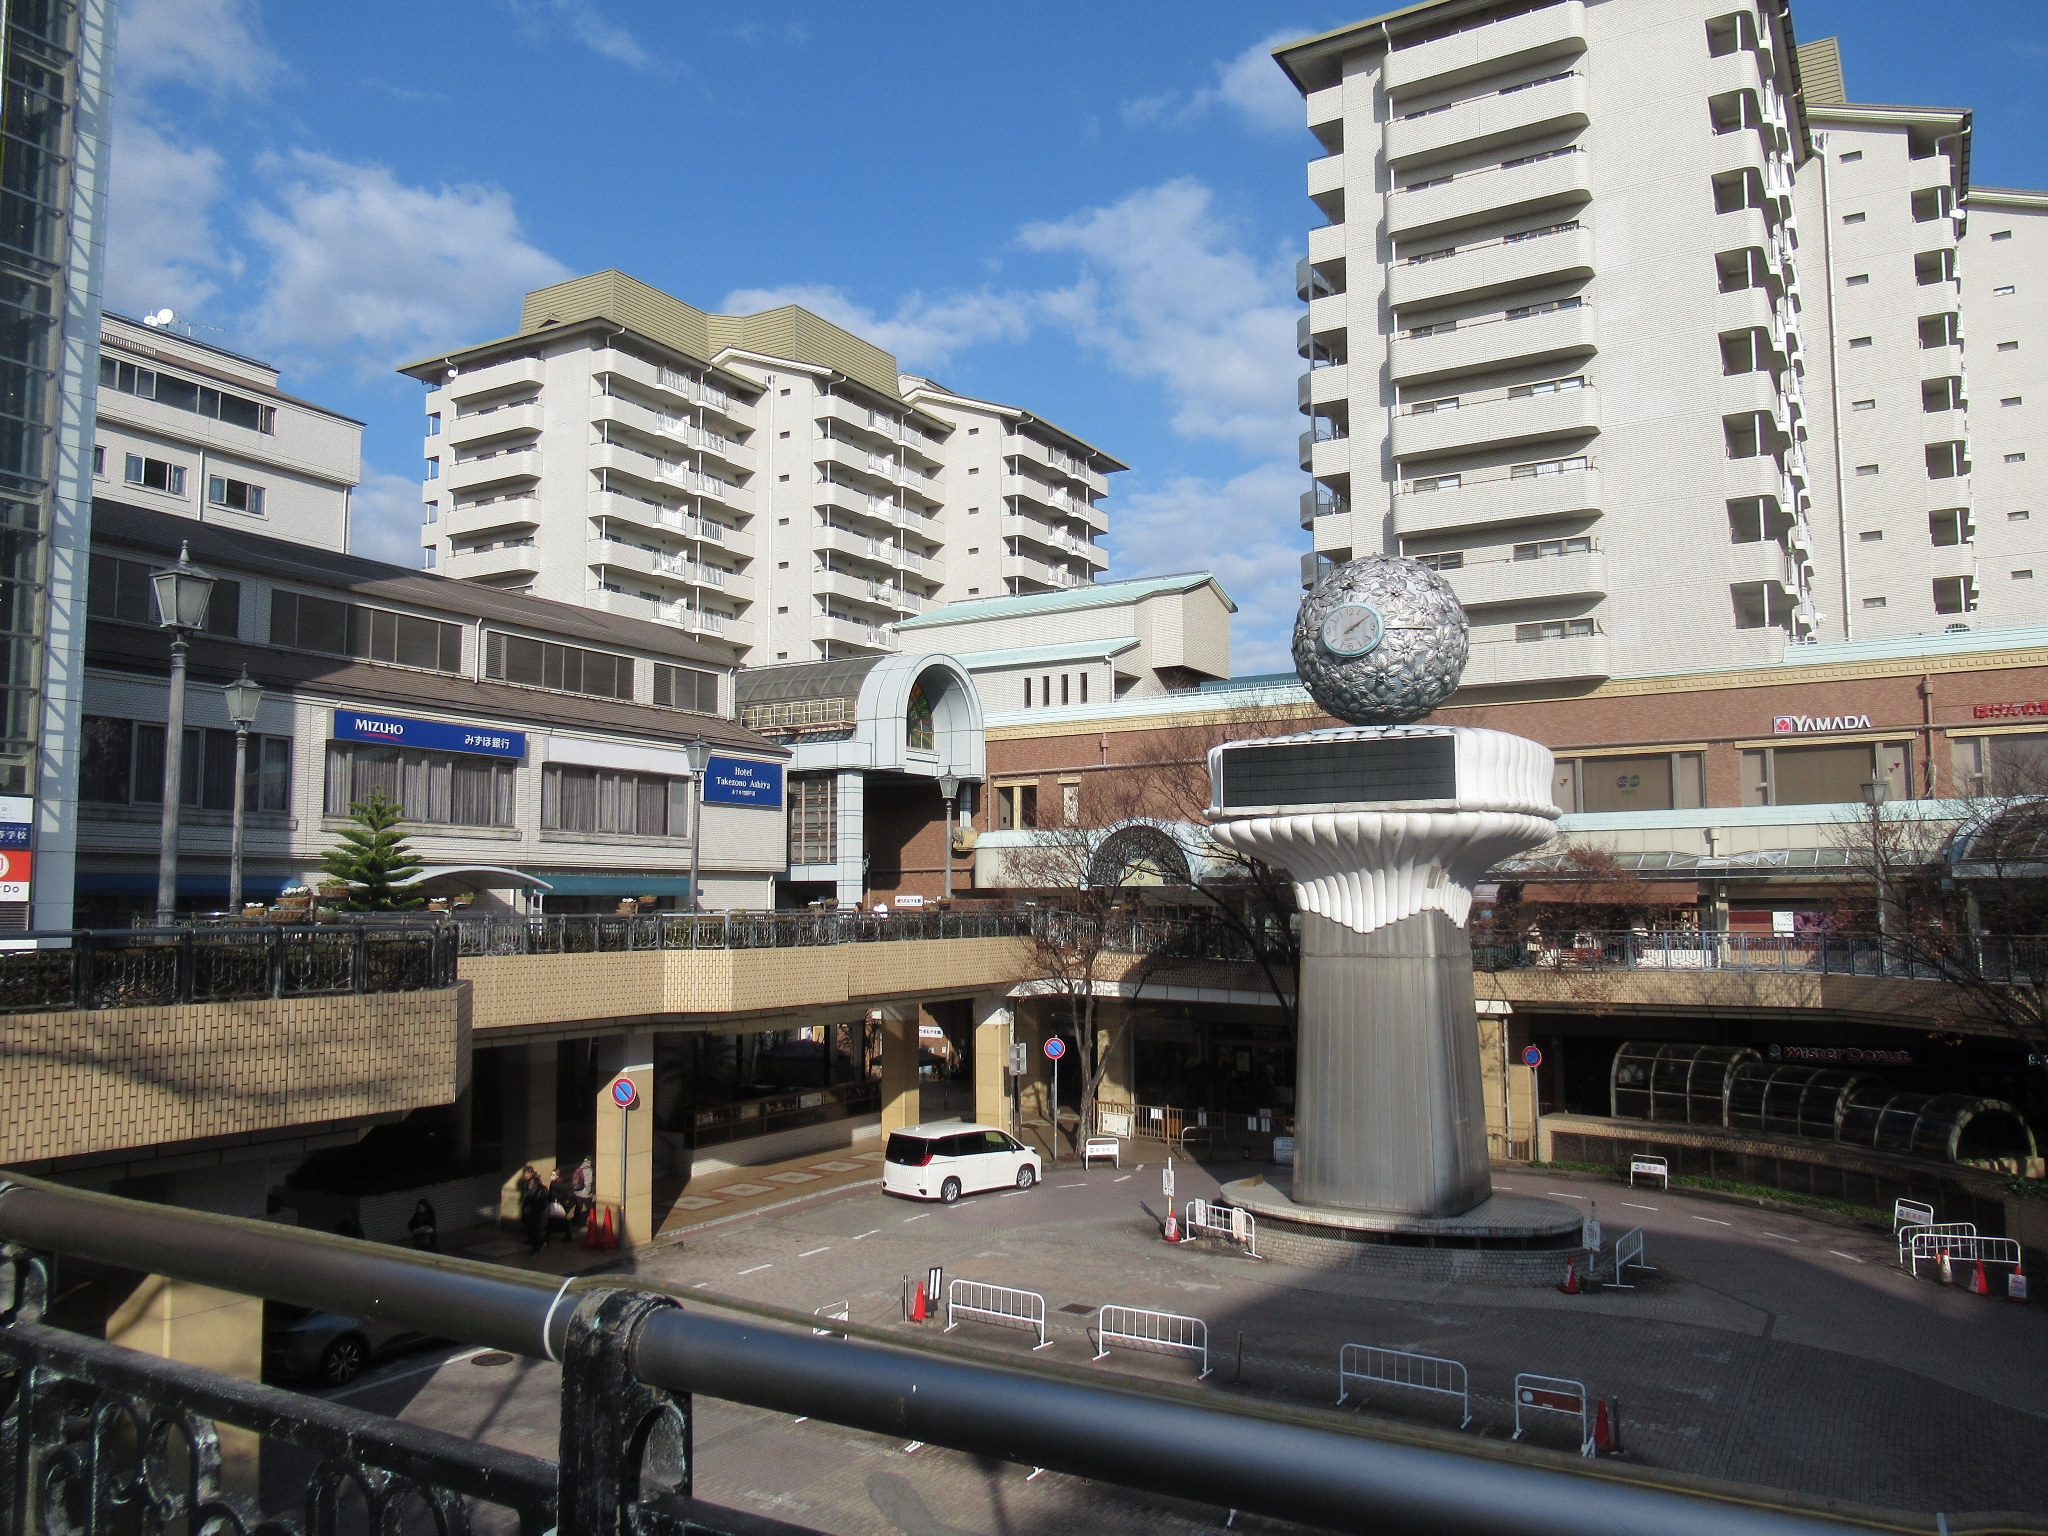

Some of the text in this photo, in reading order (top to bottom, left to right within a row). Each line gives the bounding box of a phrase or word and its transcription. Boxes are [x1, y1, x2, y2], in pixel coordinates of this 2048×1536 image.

[355, 718, 404, 735] MIZUHO
[1792, 715, 1871, 731] YAMADA
[464, 734, 510, 750] みずほ銀行
[735, 767, 752, 777] Hotel
[716, 776, 771, 790] Takezono Ashiya
[1846, 1047, 1911, 1062] Donut
